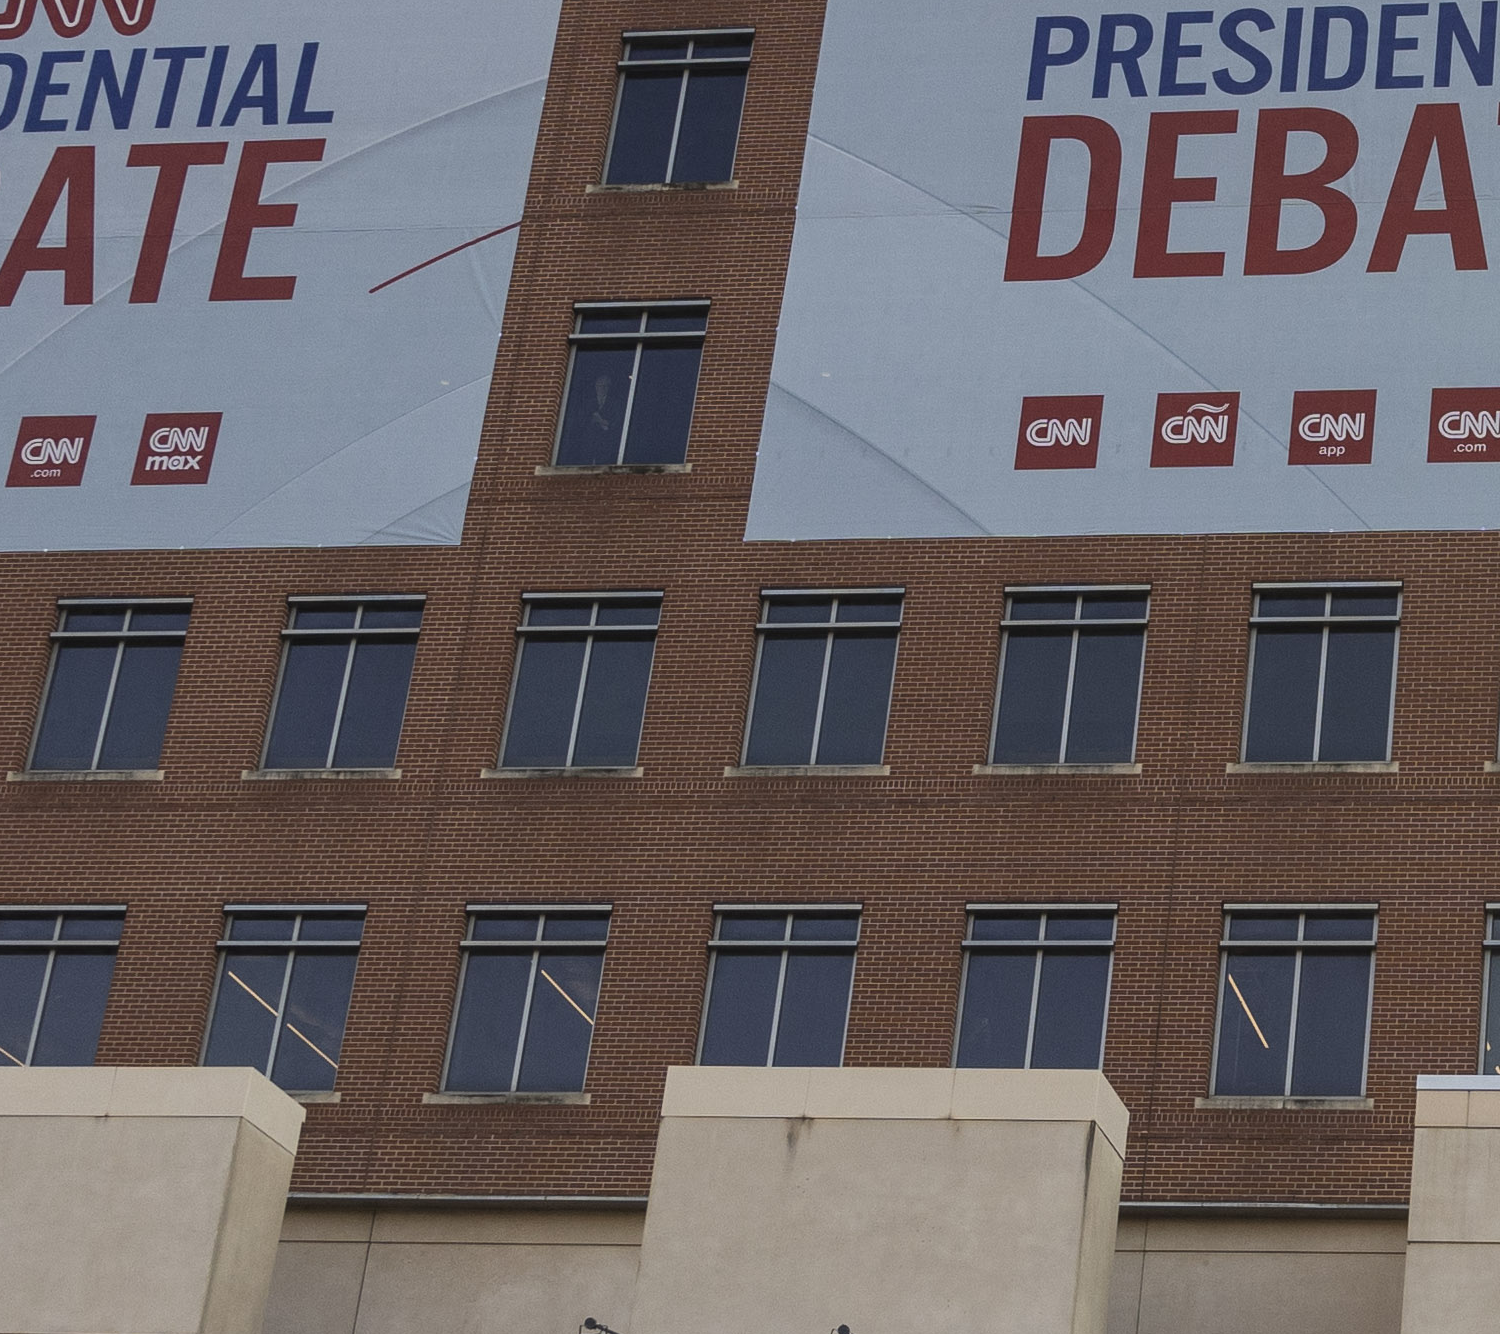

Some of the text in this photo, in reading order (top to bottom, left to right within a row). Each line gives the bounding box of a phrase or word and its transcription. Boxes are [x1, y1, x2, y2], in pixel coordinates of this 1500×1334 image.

[1026, 418, 1092, 447] CNN
[1298, 413, 1366, 441] CNN
[149, 426, 209, 453] CNN
[1453, 443, 1487, 453] .com
[21, 438, 84, 465] CNN
[1318, 445, 1346, 456] app
[30, 468, 61, 478] .com
[144, 455, 203, 471] max
